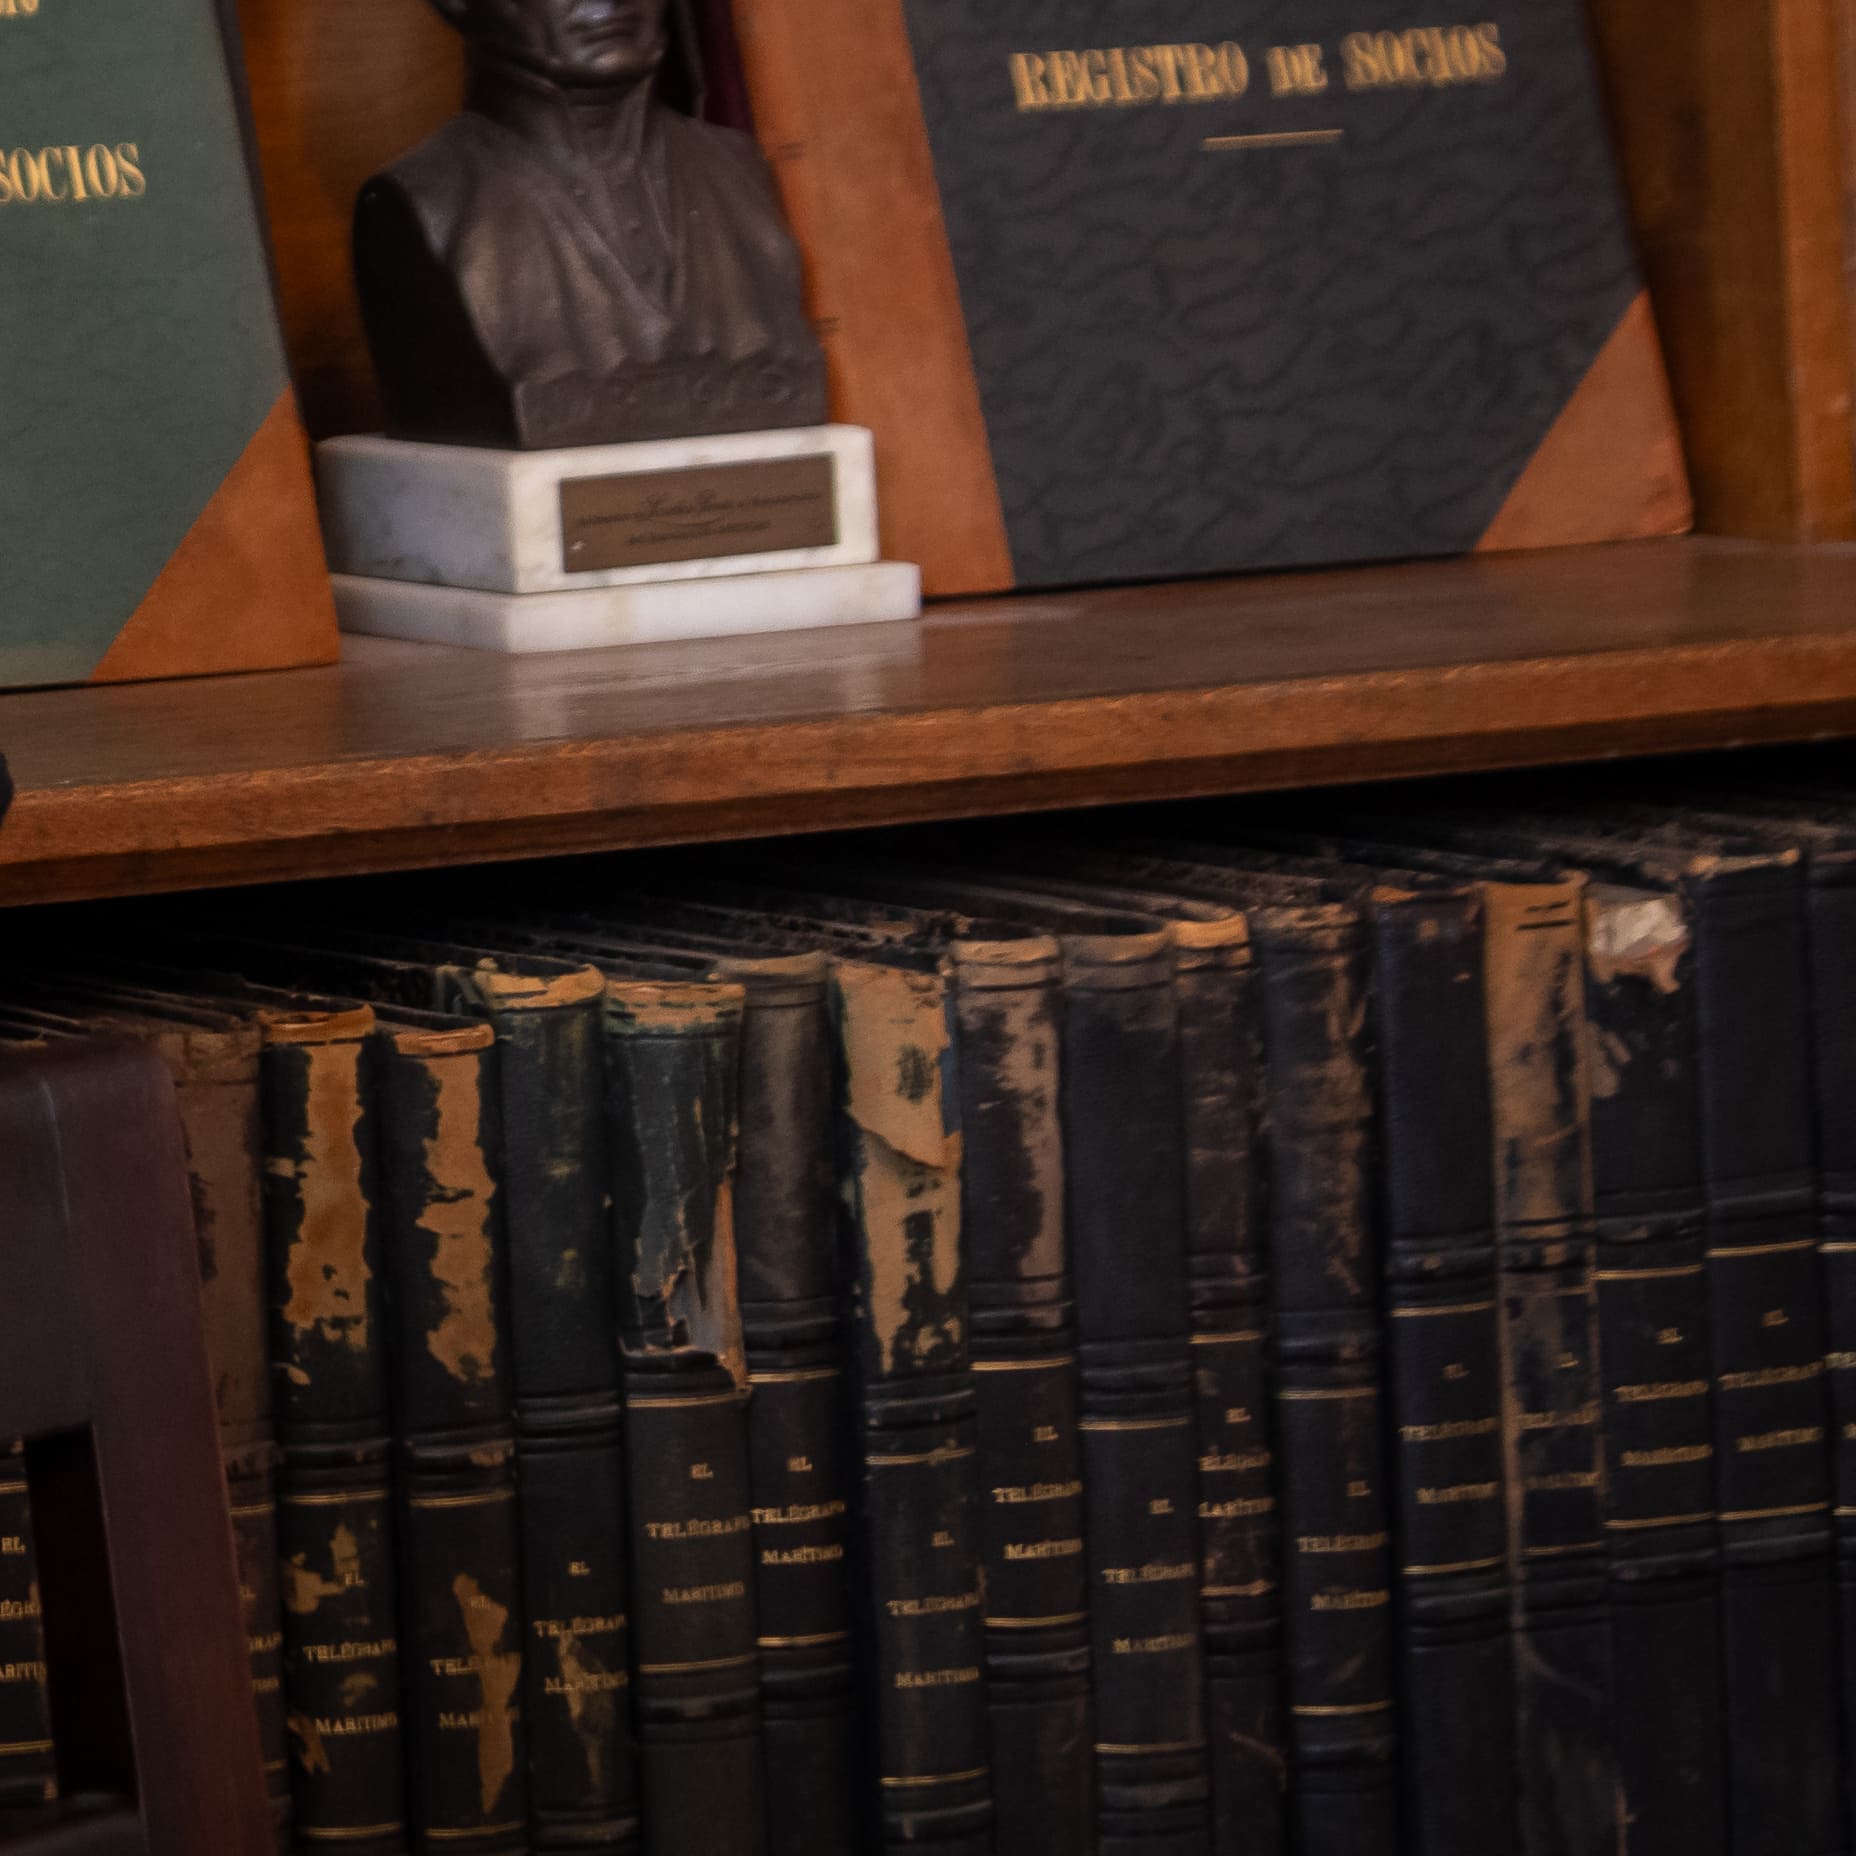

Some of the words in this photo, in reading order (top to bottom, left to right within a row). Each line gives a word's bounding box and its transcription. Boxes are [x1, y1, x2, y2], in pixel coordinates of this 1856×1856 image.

[1008, 43, 1249, 112] REGISTRO
[1267, 44, 1327, 98] DE
[1341, 24, 1507, 92] SOCIOS
